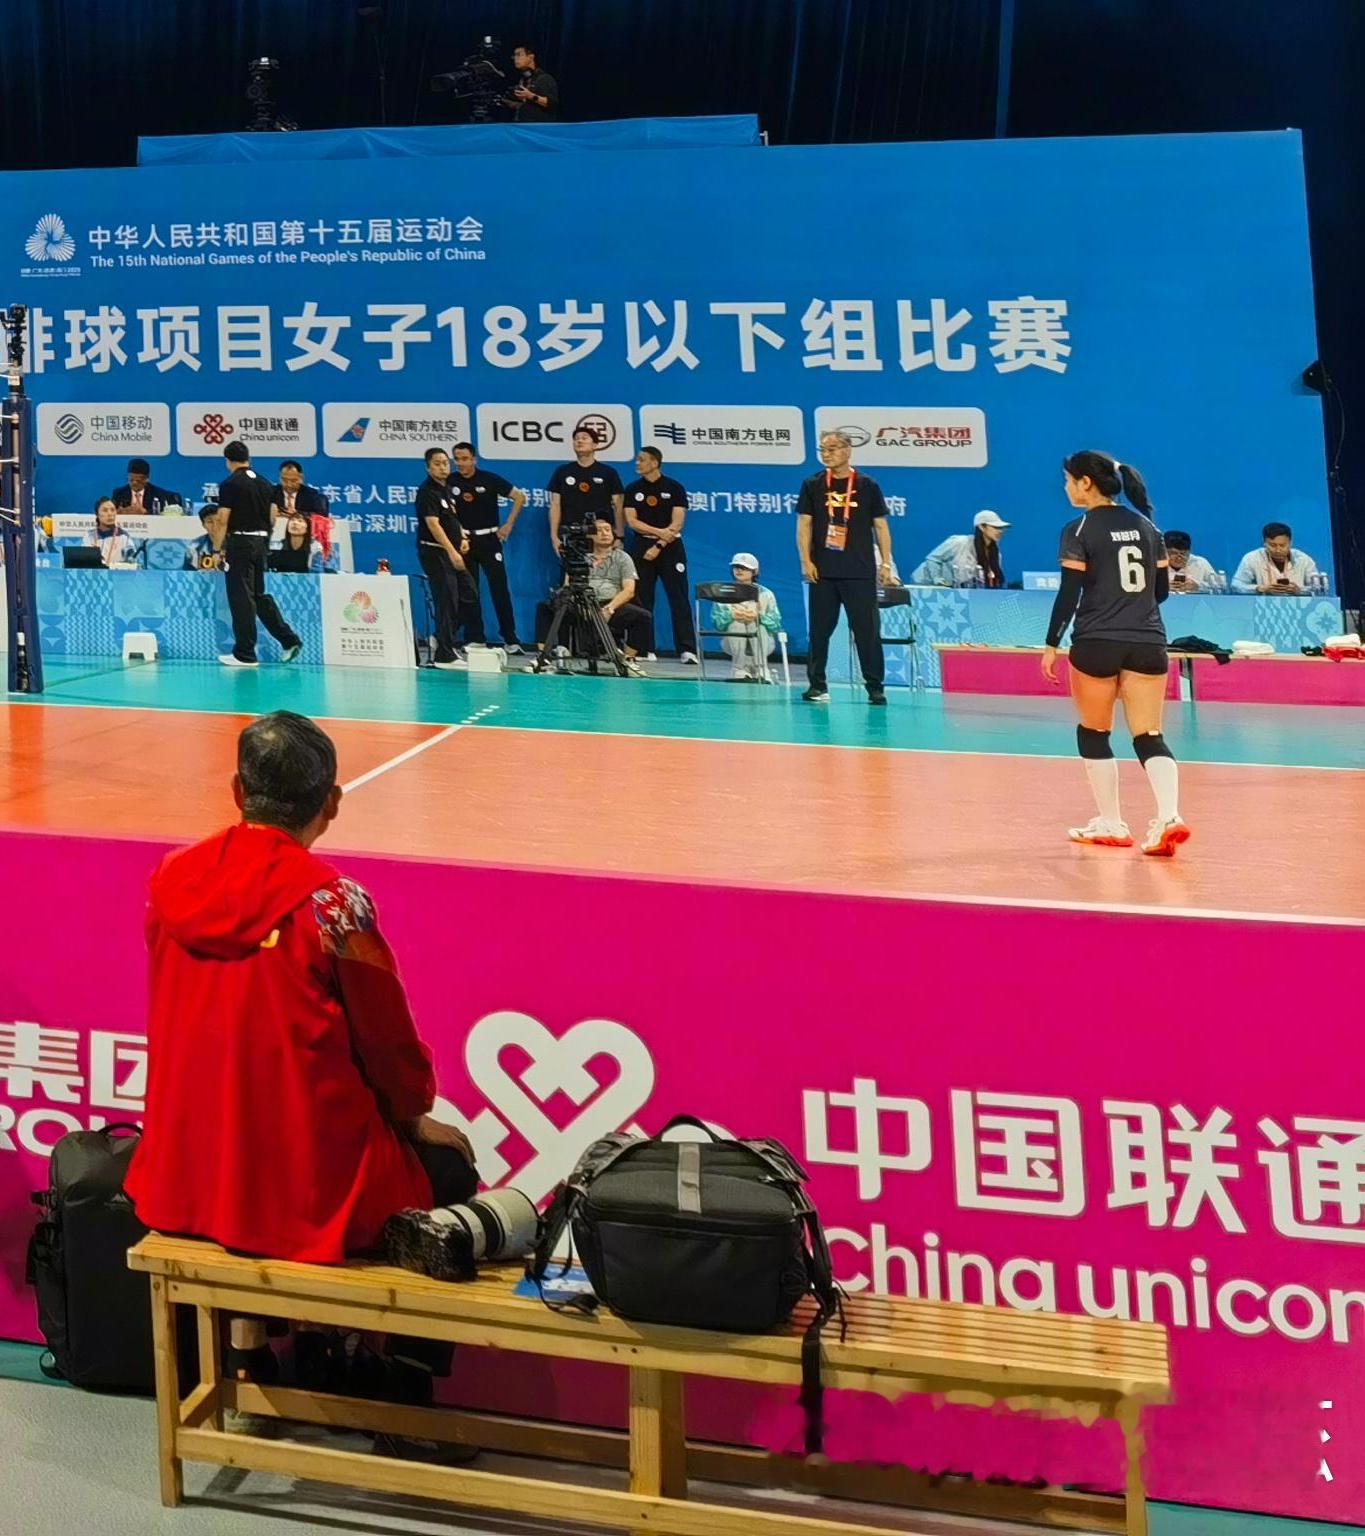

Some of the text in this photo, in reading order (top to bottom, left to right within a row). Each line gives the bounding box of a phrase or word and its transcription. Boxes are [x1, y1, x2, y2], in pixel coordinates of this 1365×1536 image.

[88, 216, 483, 250] 中华人民共和国第十五届运动会
[90, 247, 486, 267] The 15th National Games of the People's Republic of China
[90, 415, 152, 430] 中国移动
[238, 417, 299, 432] 中国联通
[379, 419, 458, 433] 中国南方航空
[91, 432, 152, 442] China Mobile
[239, 433, 300, 442] China unicom
[379, 432, 458, 442] CHINA SOUTHERN
[493, 421, 564, 442] ICBC
[692, 427, 791, 441] 中国南方电网
[876, 426, 972, 439] 广汽集团
[876, 438, 972, 448] GAC GROUP
[1118, 545, 1147, 593] 6
[802, 1077, 1365, 1244] 中国联通
[823, 1222, 1058, 1313] China
